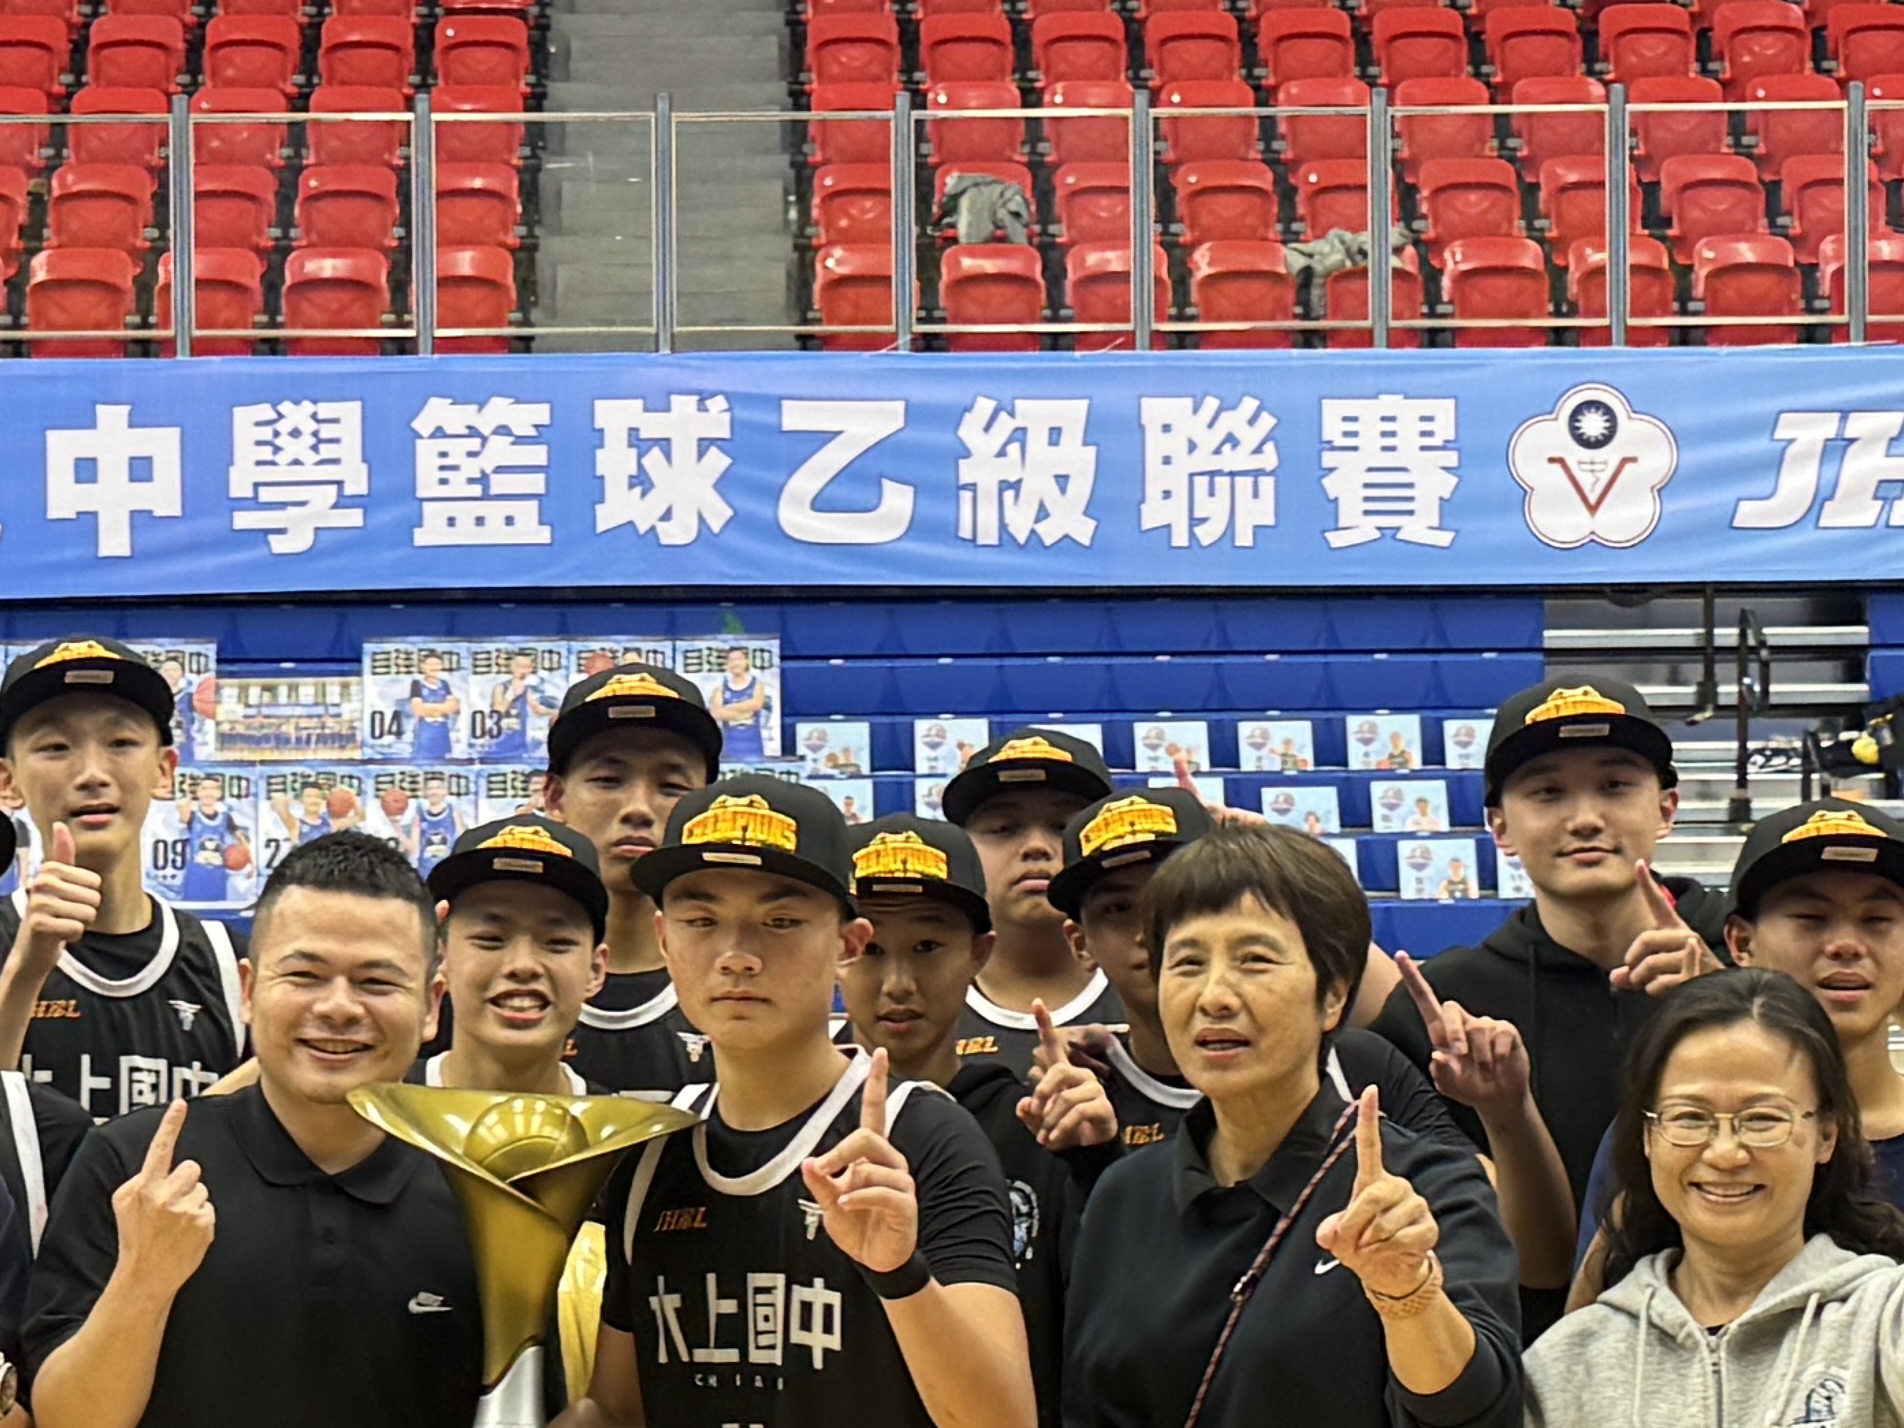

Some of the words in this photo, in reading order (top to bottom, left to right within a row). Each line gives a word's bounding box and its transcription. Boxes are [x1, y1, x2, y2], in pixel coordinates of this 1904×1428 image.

[370, 709, 404, 740] 04
[471, 709, 503, 740] 03
[152, 839, 188, 871] 09
[22, 1053, 220, 1125] 上國中
